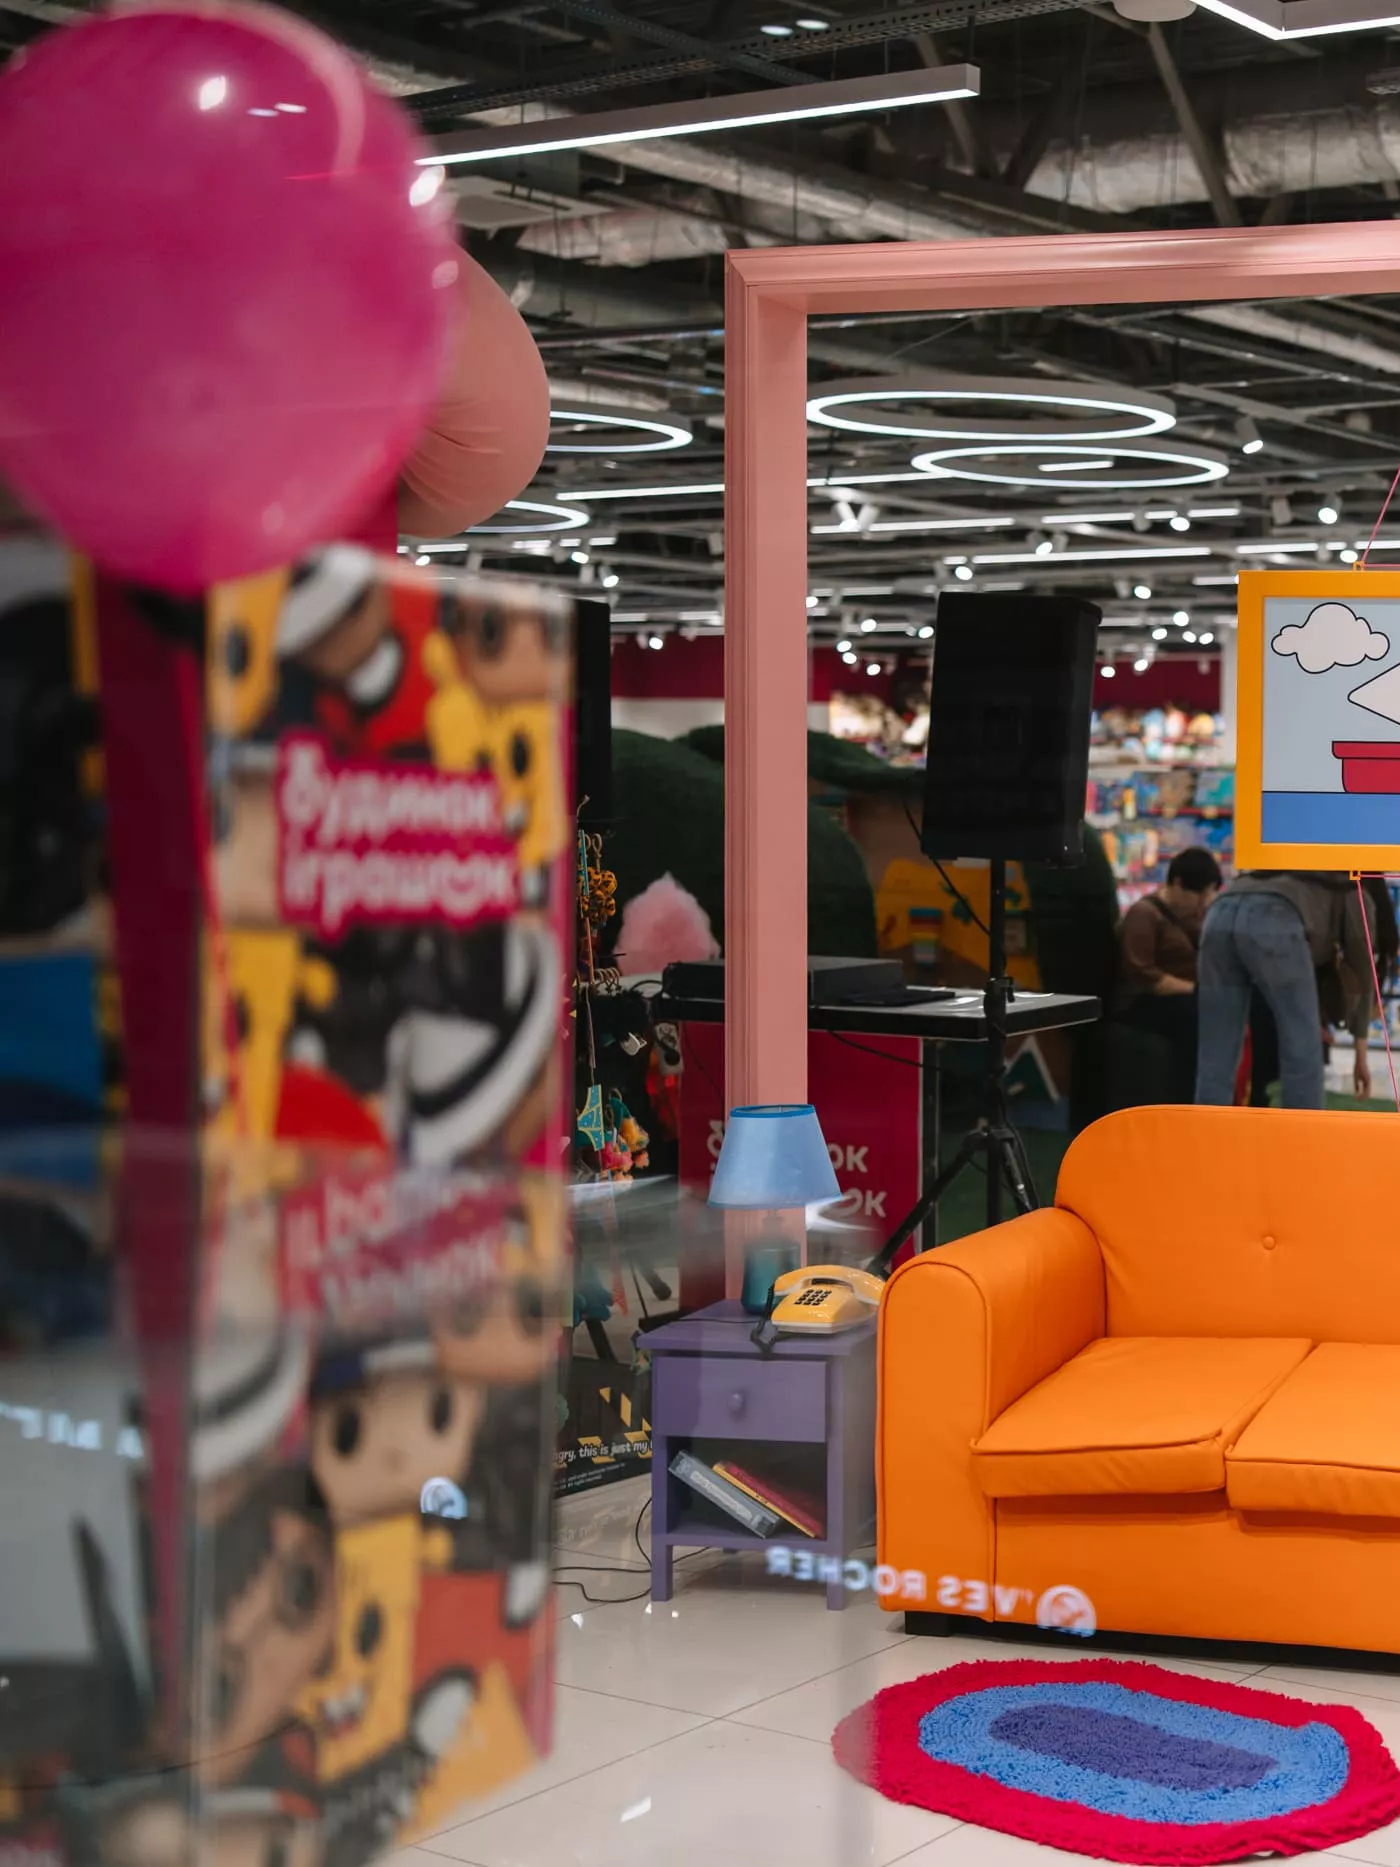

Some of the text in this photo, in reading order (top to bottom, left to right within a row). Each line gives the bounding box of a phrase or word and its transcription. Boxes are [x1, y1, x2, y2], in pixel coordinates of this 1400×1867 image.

[579, 1444, 597, 1458] this
[600, 1444, 608, 1455] is
[610, 1442, 631, 1457] just
[633, 1441, 648, 1453] my
